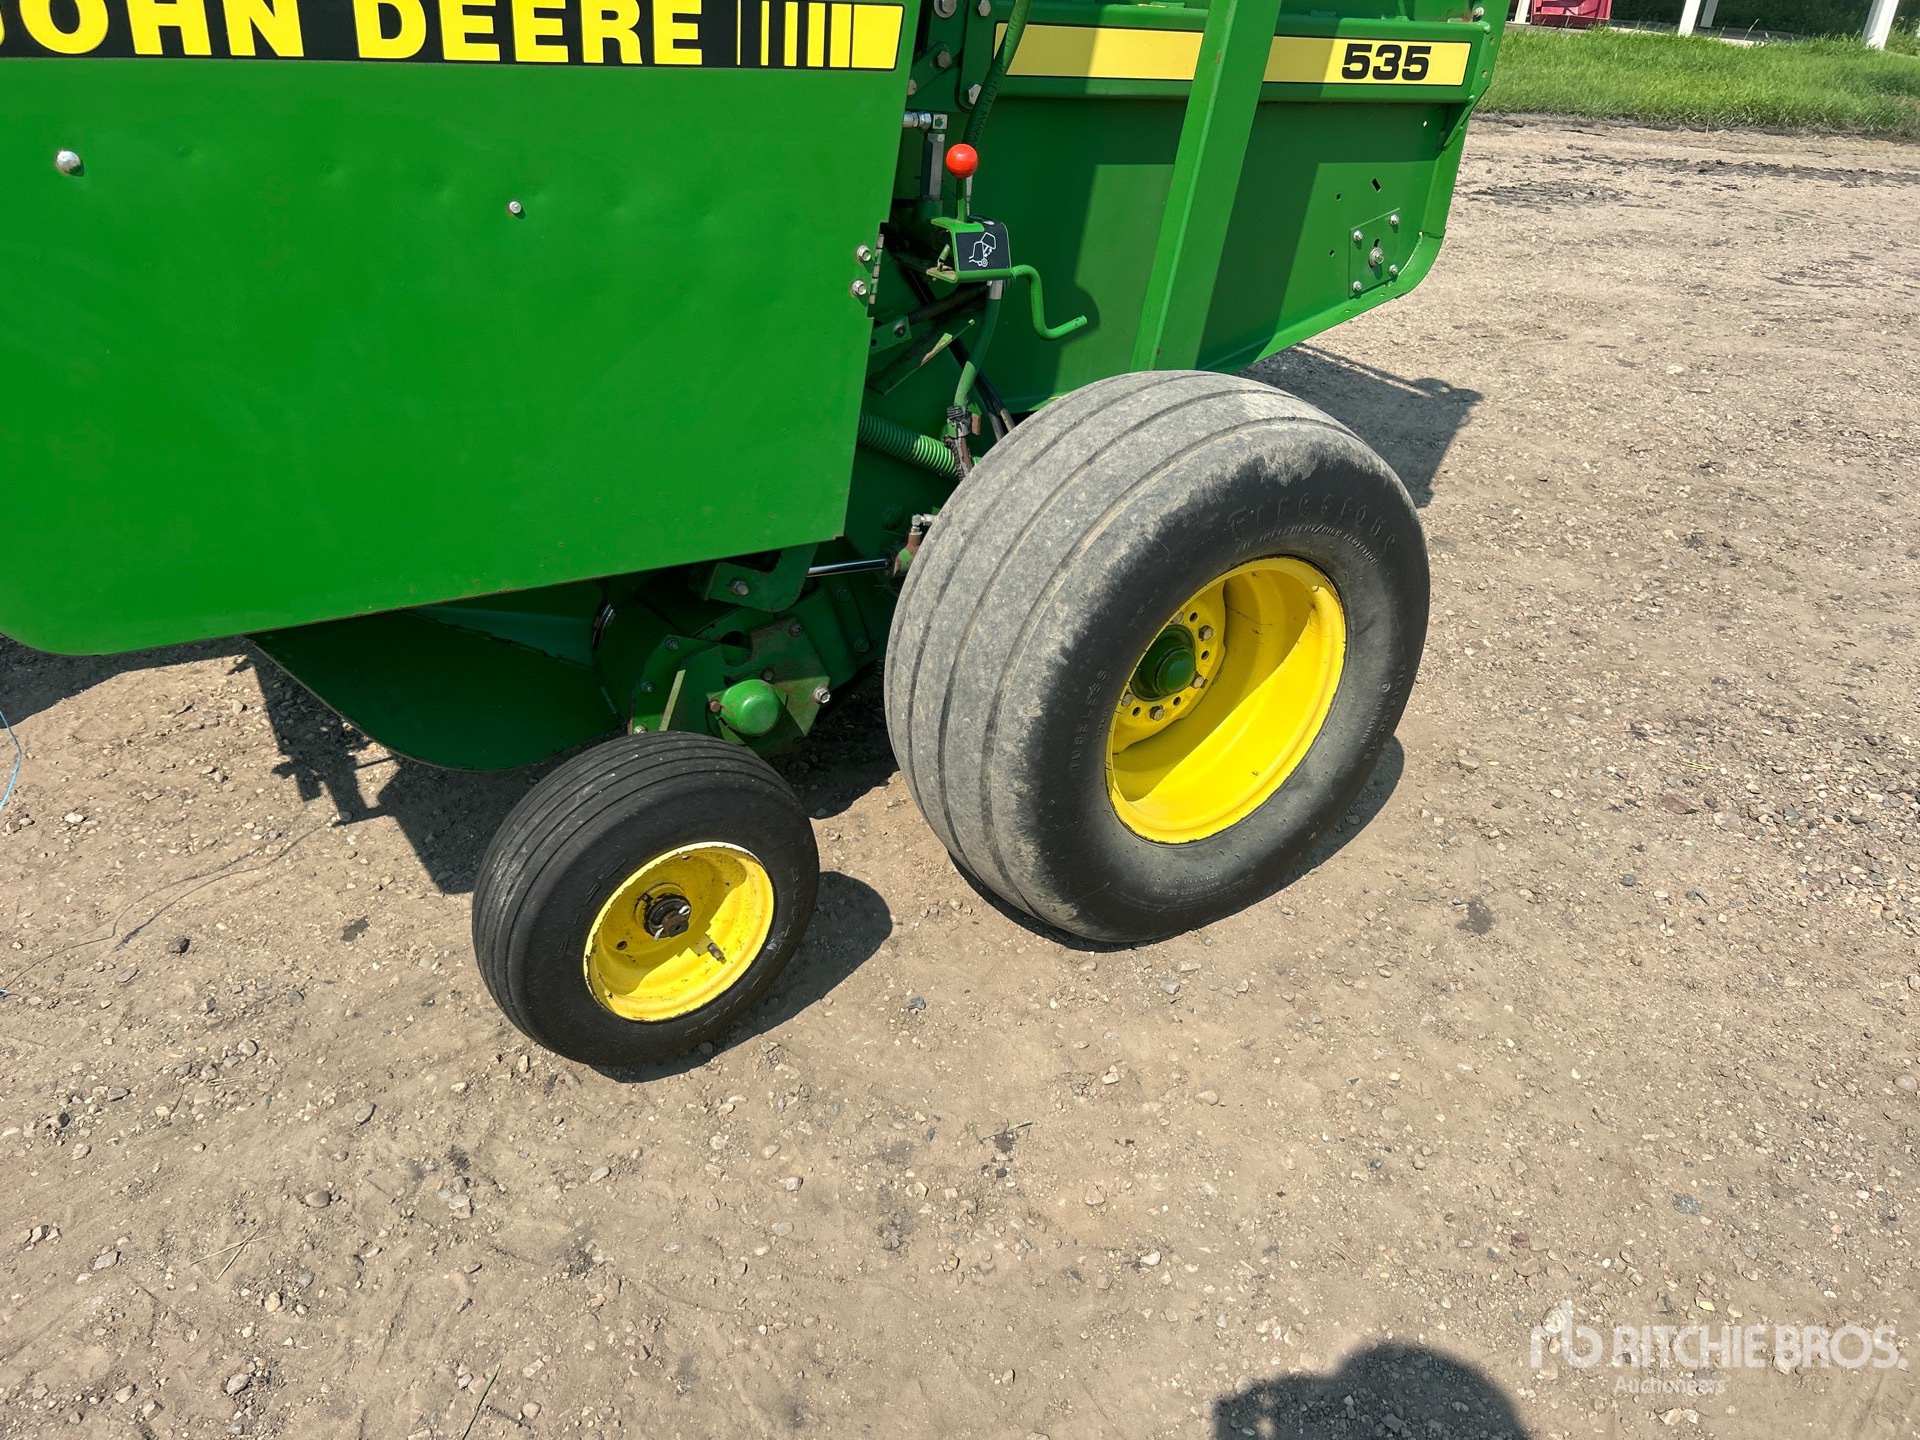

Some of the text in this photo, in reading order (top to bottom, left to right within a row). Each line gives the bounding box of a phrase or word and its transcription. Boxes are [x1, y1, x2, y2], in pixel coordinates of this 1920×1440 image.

[0, 0, 704, 65] OHN DEERE
[1341, 43, 1432, 81] 535
